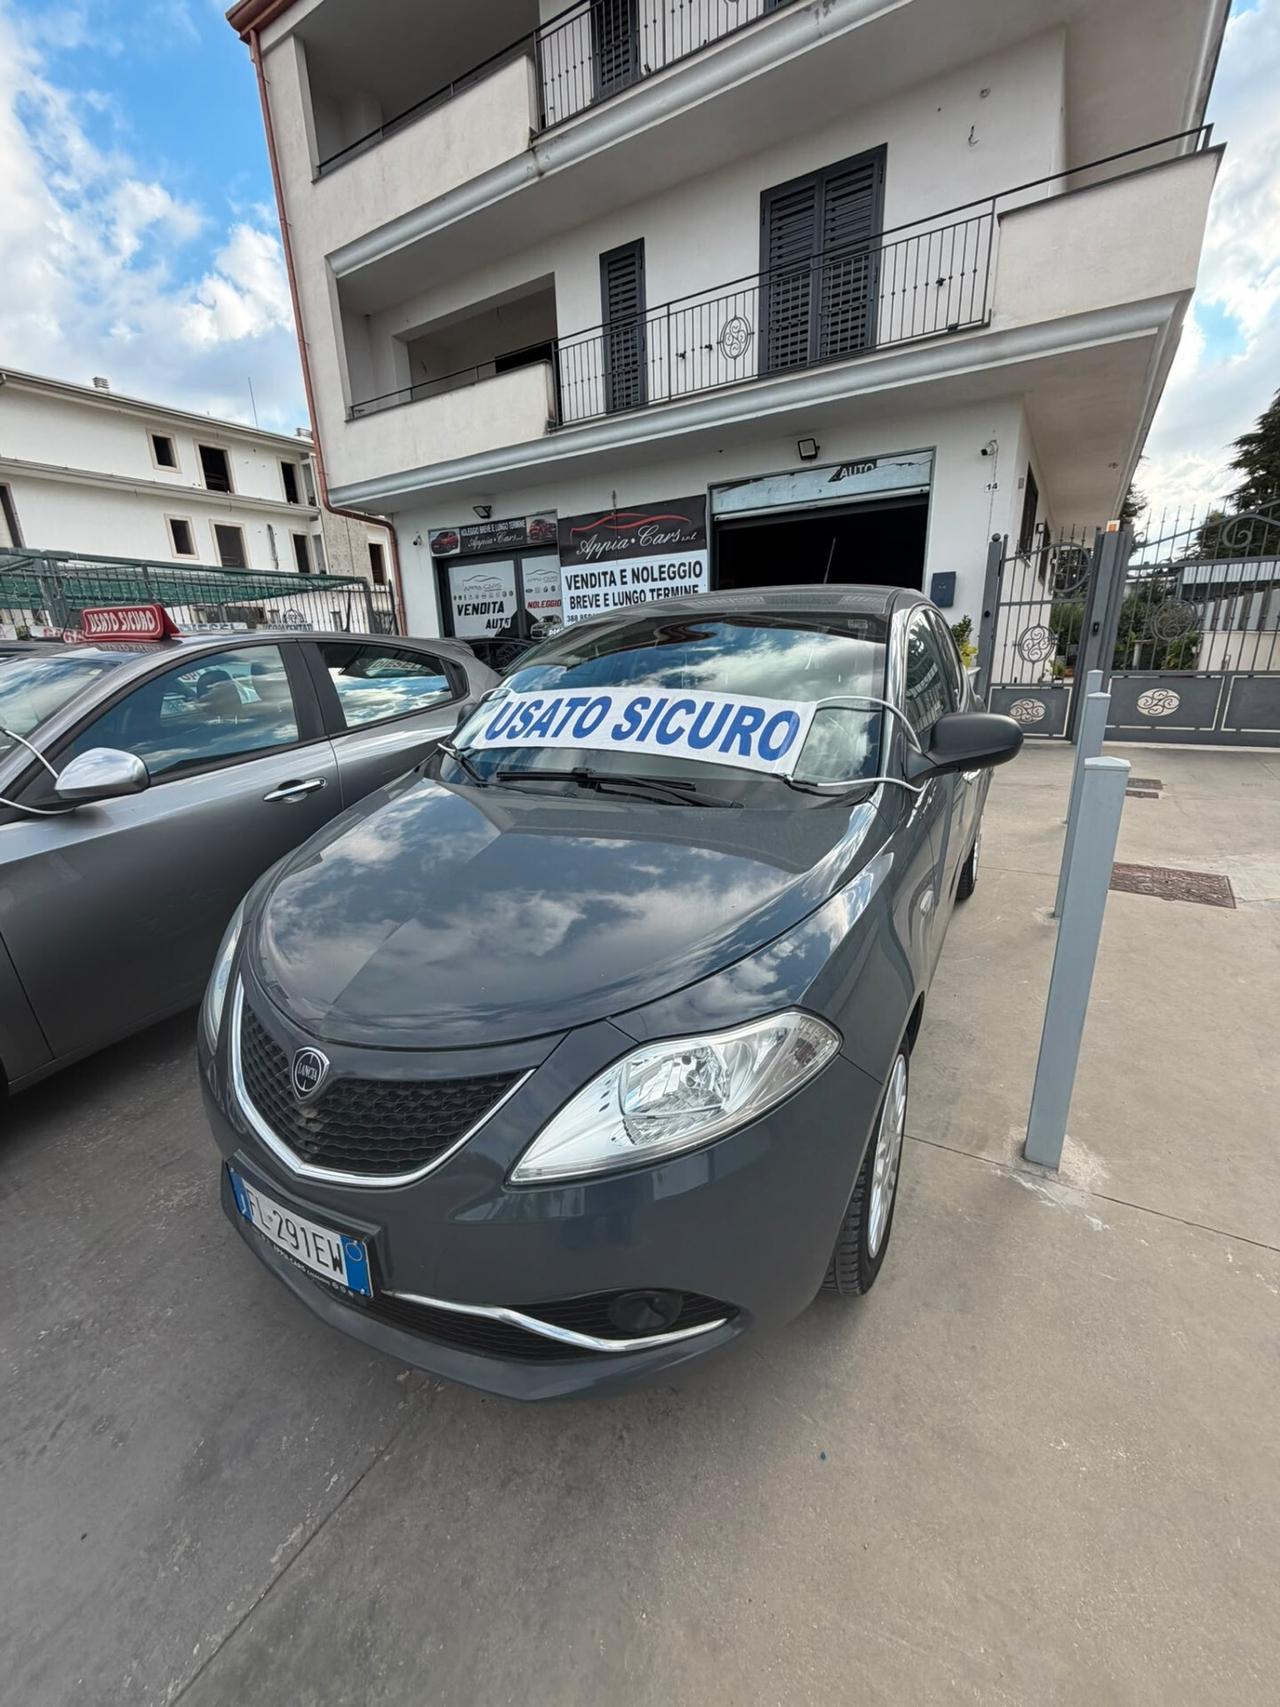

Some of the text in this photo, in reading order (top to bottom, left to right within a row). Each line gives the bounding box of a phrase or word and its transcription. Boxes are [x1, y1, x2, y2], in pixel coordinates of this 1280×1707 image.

[840, 463, 874, 478] AUTO
[576, 534, 630, 560] Appia
[638, 524, 681, 546] Cars
[565, 560, 703, 591] VENDITA E NOLEGGIO
[457, 601, 504, 616] VENDITA
[527, 600, 561, 609] NOLEGGIO
[570, 584, 699, 610] BREVE E LUNGO TERMINE
[87, 610, 155, 632] USATO SICURO
[485, 696, 801, 761] USATO SICURO
